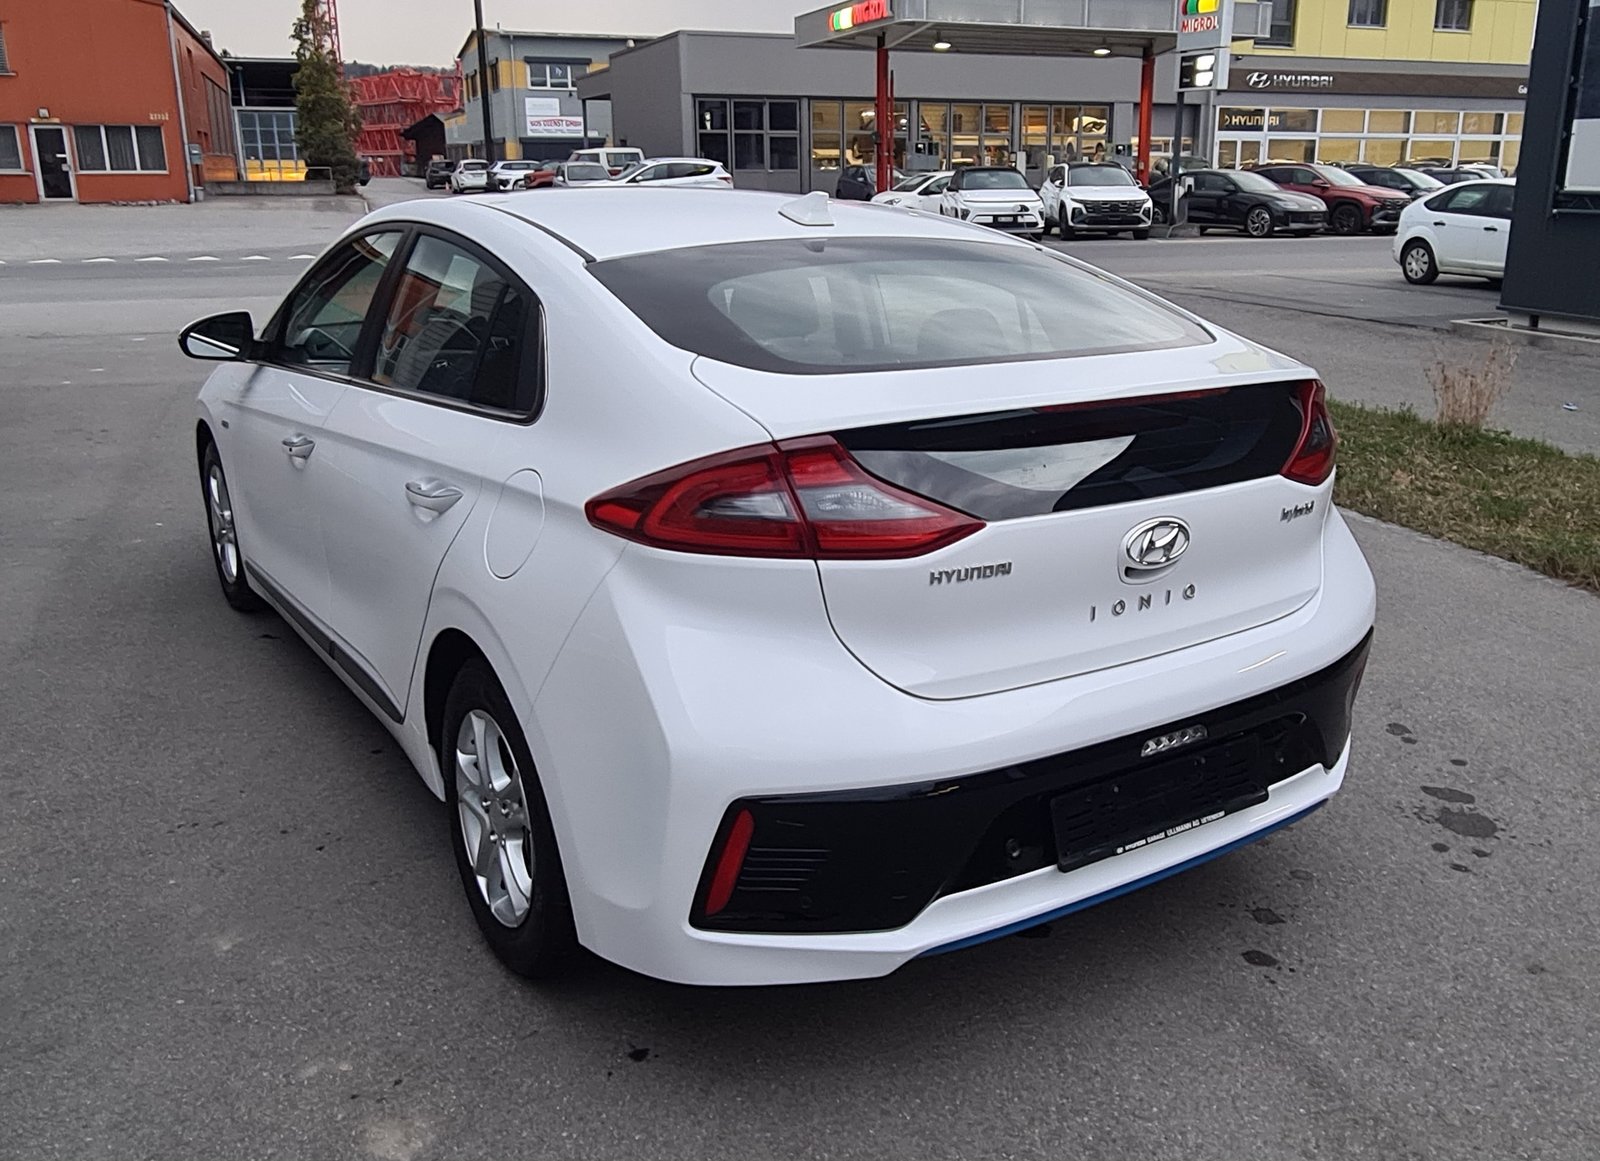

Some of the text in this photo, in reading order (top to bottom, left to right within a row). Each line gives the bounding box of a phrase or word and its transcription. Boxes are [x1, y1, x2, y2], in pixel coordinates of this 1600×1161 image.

[853, 0, 888, 25] MIGROL
[1181, 16, 1218, 32] MIGROL
[1273, 74, 1334, 87] HYUNDAI
[1280, 500, 1314, 523] hybrid
[930, 562, 1012, 586] HYUNDAI
[1090, 583, 1197, 622] IONIQ
[1166, 822, 1192, 836] ULLMANN
